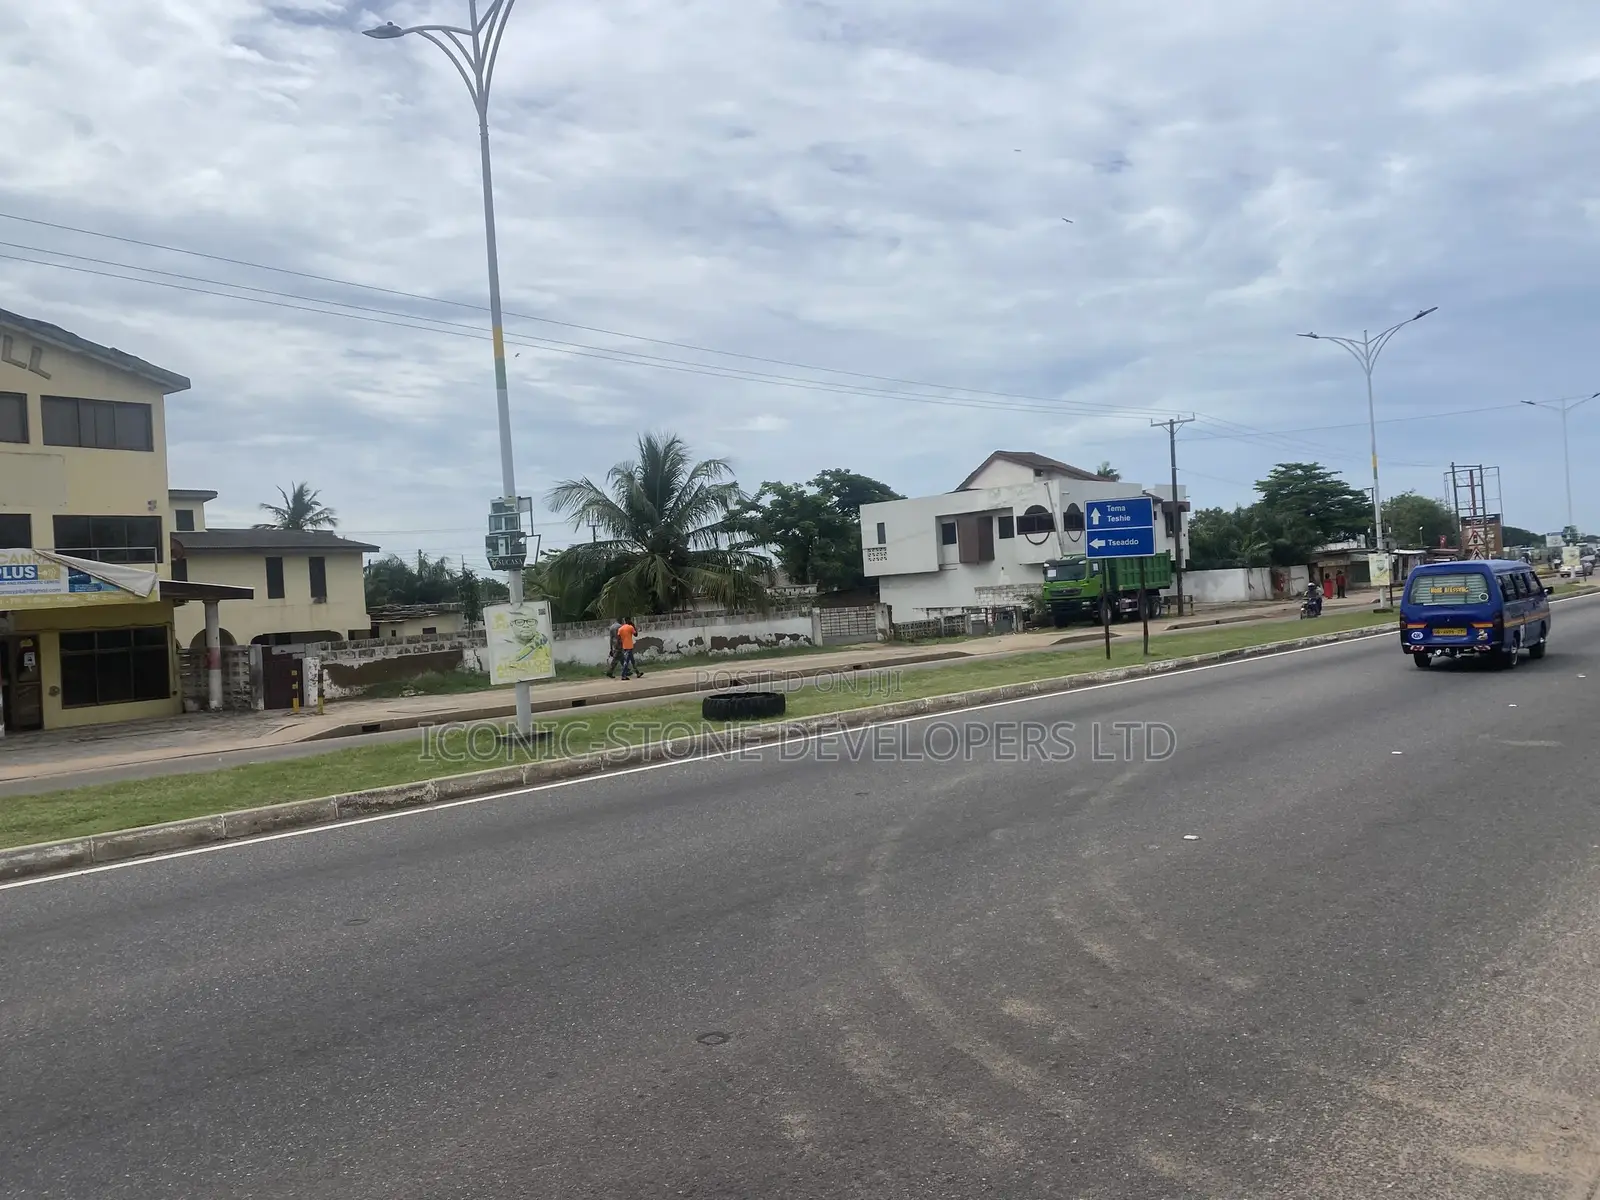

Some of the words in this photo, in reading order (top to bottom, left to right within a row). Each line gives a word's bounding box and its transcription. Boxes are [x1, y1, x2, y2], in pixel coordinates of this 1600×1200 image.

[1106, 504, 1126, 512] Tema
[1107, 514, 1131, 522] Teshie
[1108, 538, 1139, 546] Tseaddo
[0, 565, 36, 579] LUS
